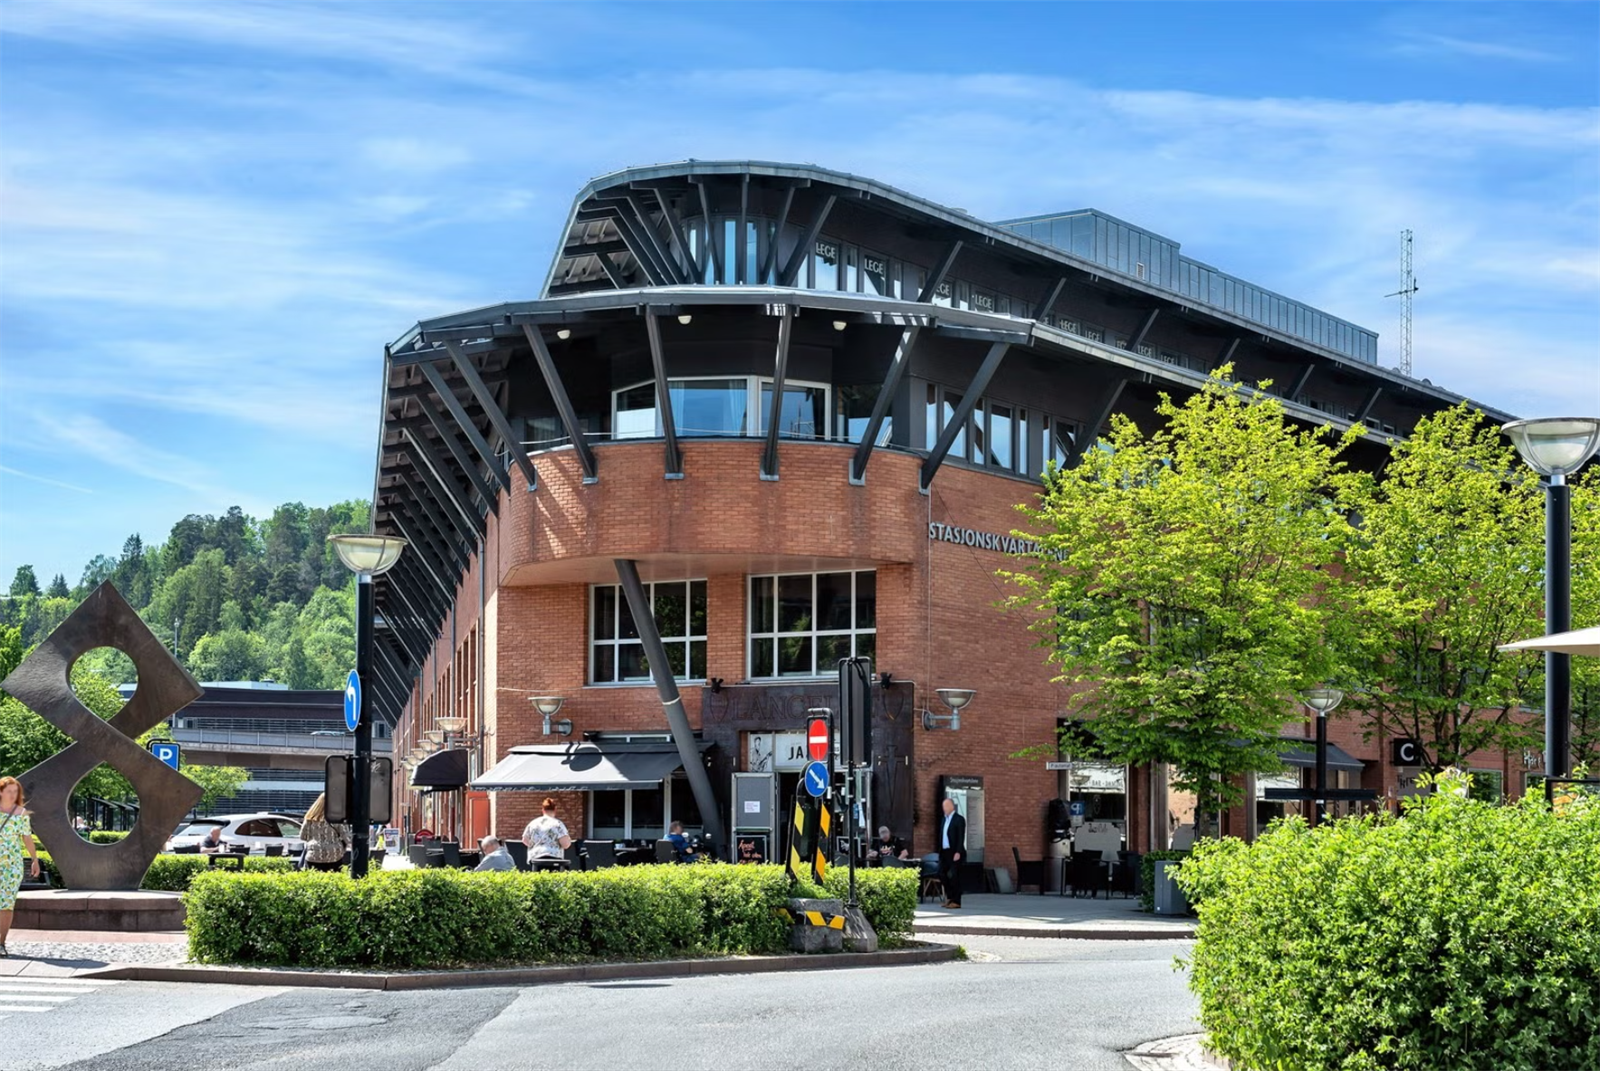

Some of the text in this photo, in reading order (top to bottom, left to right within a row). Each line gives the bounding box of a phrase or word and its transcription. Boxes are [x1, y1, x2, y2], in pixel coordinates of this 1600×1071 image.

[816, 242, 836, 259] LEGE
[864, 258, 884, 275] LEGE
[975, 294, 992, 309] LEGE
[1060, 319, 1076, 334] LEGE
[159, 748, 173, 761] P
[1400, 743, 1414, 762] C
